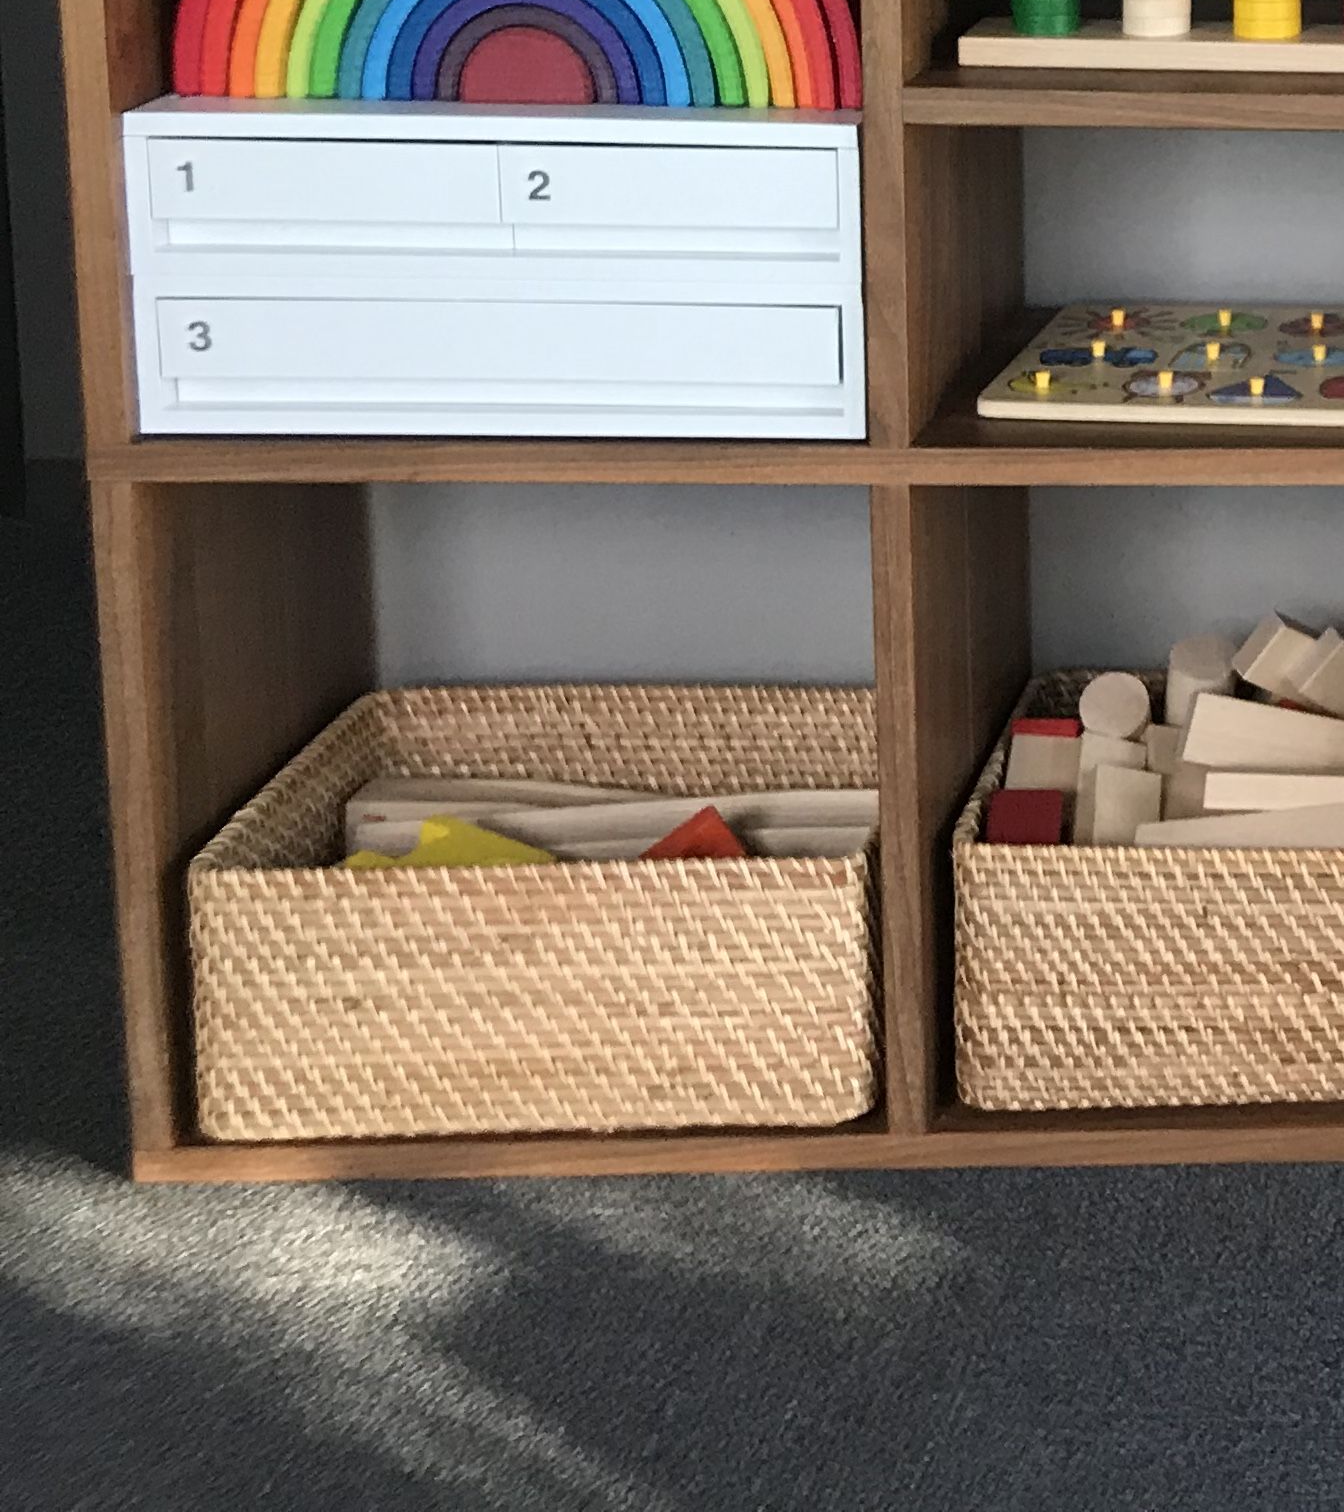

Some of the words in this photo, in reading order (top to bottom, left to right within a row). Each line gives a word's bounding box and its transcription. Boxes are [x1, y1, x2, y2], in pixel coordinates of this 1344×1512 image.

[175, 162, 197, 193] 1
[526, 170, 552, 202] 2
[187, 320, 214, 353] 3
